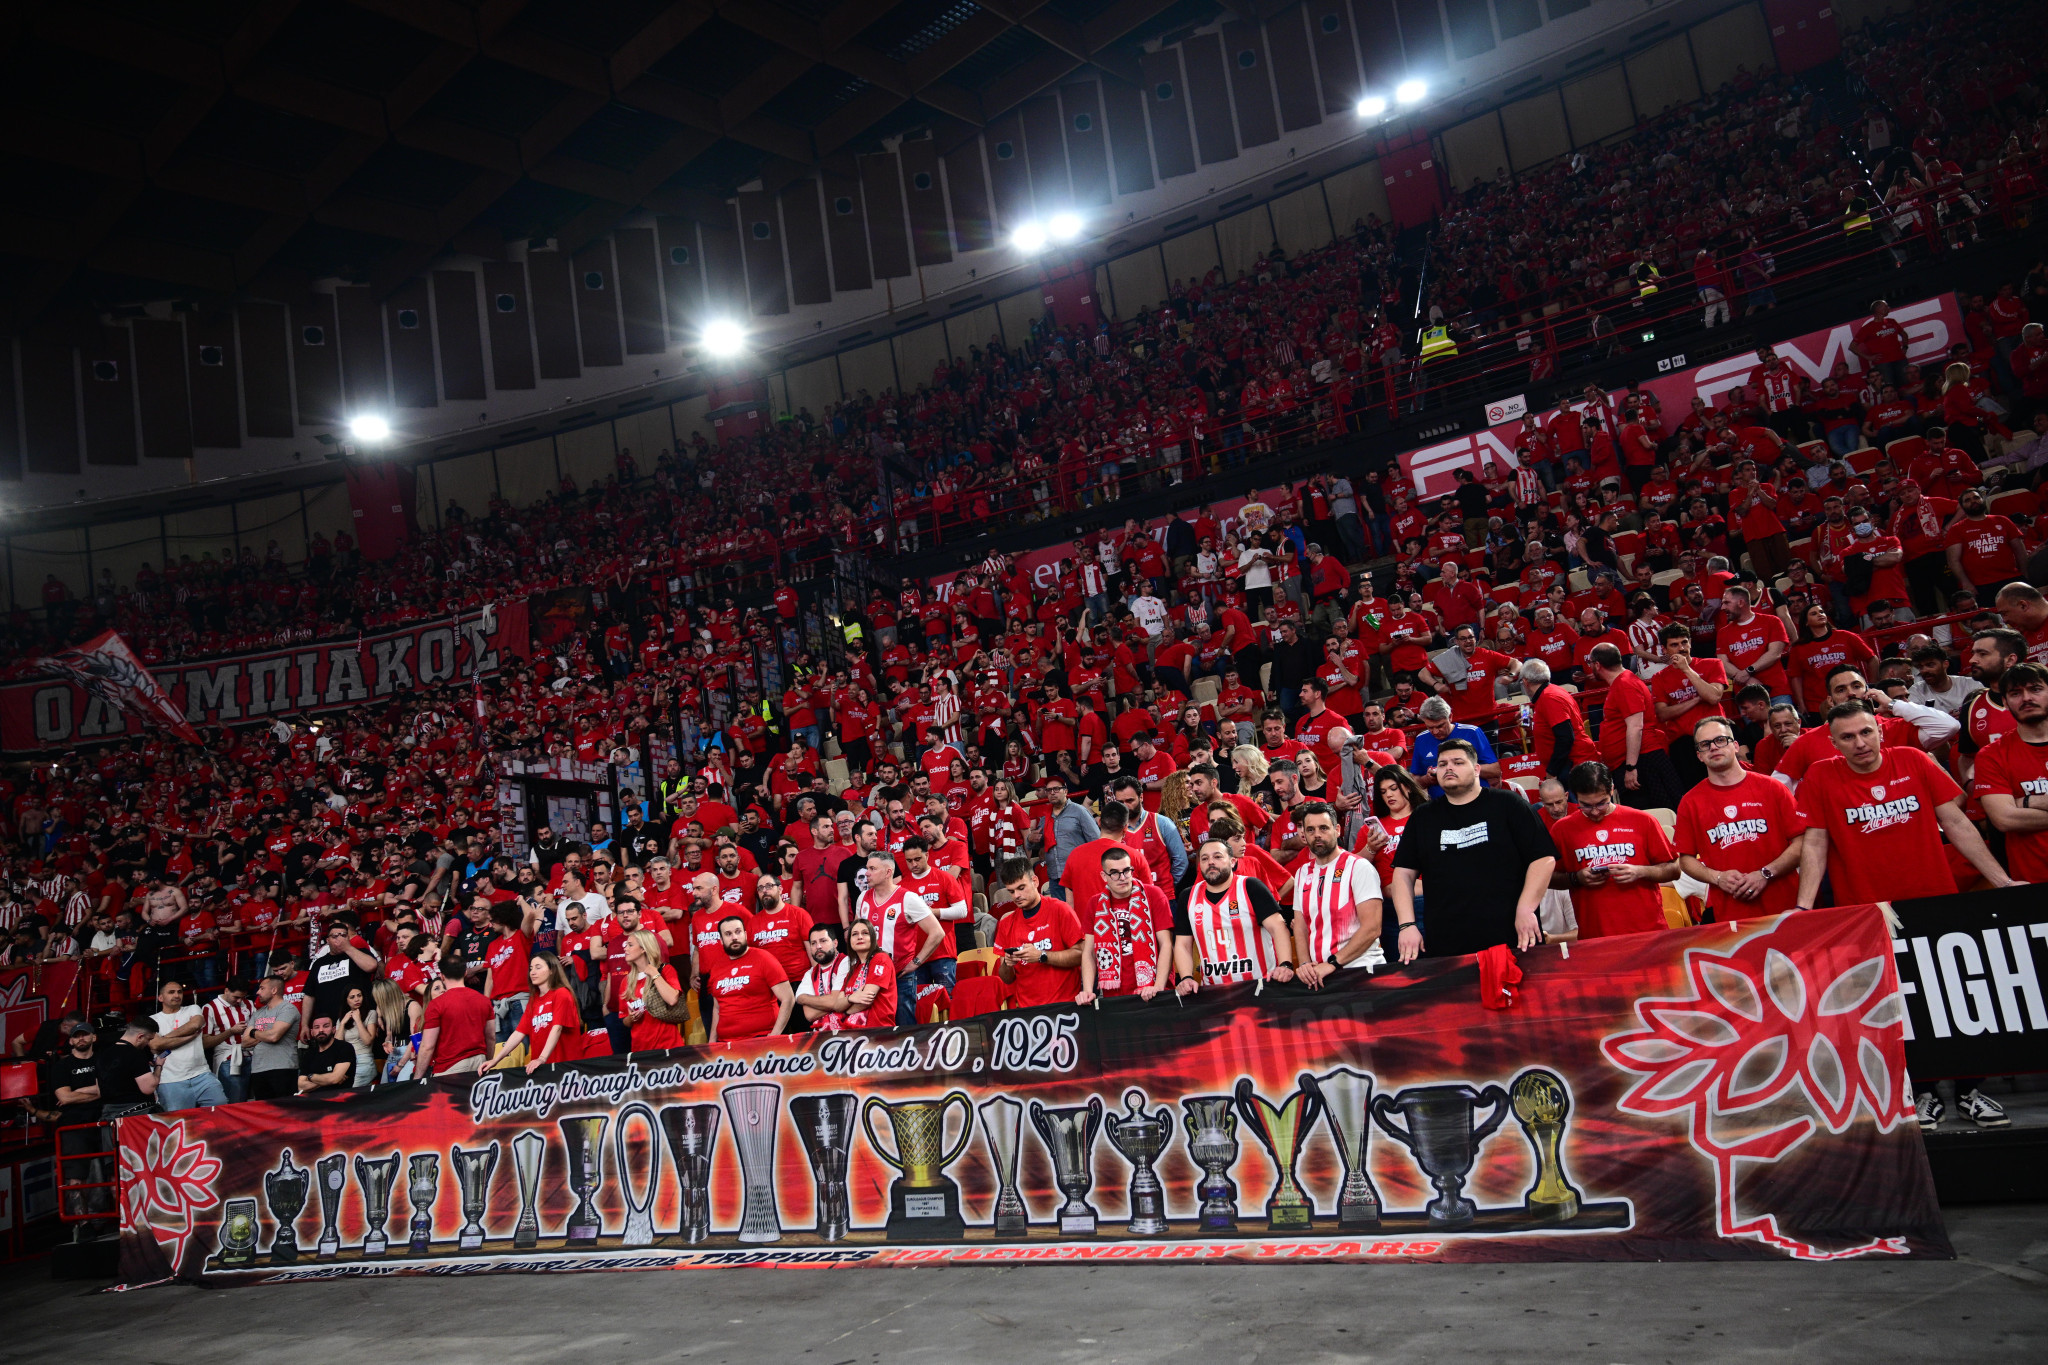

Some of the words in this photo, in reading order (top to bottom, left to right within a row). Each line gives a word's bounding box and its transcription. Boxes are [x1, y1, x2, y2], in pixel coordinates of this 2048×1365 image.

[1770, 391, 1791, 403] bwin
[1968, 535, 2005, 549] PIRAEUS
[1977, 544, 1998, 554] TIME
[1145, 617, 1162, 625] bwin
[1728, 636, 1764, 652] PIRAEUS
[1807, 651, 1846, 666] PIRAEUS
[929, 765, 949, 774] adidas
[1509, 760, 1541, 770] PIRAEUS
[1845, 795, 1920, 825] PIRAEUS
[1861, 819, 1879, 833] All
[1891, 811, 1912, 825] Way
[1706, 818, 1768, 844] PIRAEUS
[1574, 842, 1636, 863] PIRAEUS
[1319, 875, 1325, 897] 7
[753, 928, 789, 942] PIRAEUS
[1207, 928, 1232, 951] 14
[467, 942, 479, 954] 22
[1203, 954, 1253, 977] bwin
[716, 975, 750, 990] PIRAEUS
[471, 1074, 556, 1124] Flowing
[560, 1063, 643, 1101] through
[646, 1062, 686, 1089] our
[689, 1055, 748, 1082] veins
[750, 1051, 815, 1078] since
[818, 1036, 923, 1077] March
[990, 1012, 1080, 1072] 1925
[690, 1249, 879, 1265] TROPHIES
[951, 1245, 1246, 1260] LEGENDARY
[1255, 1241, 1443, 1257] YEARS
